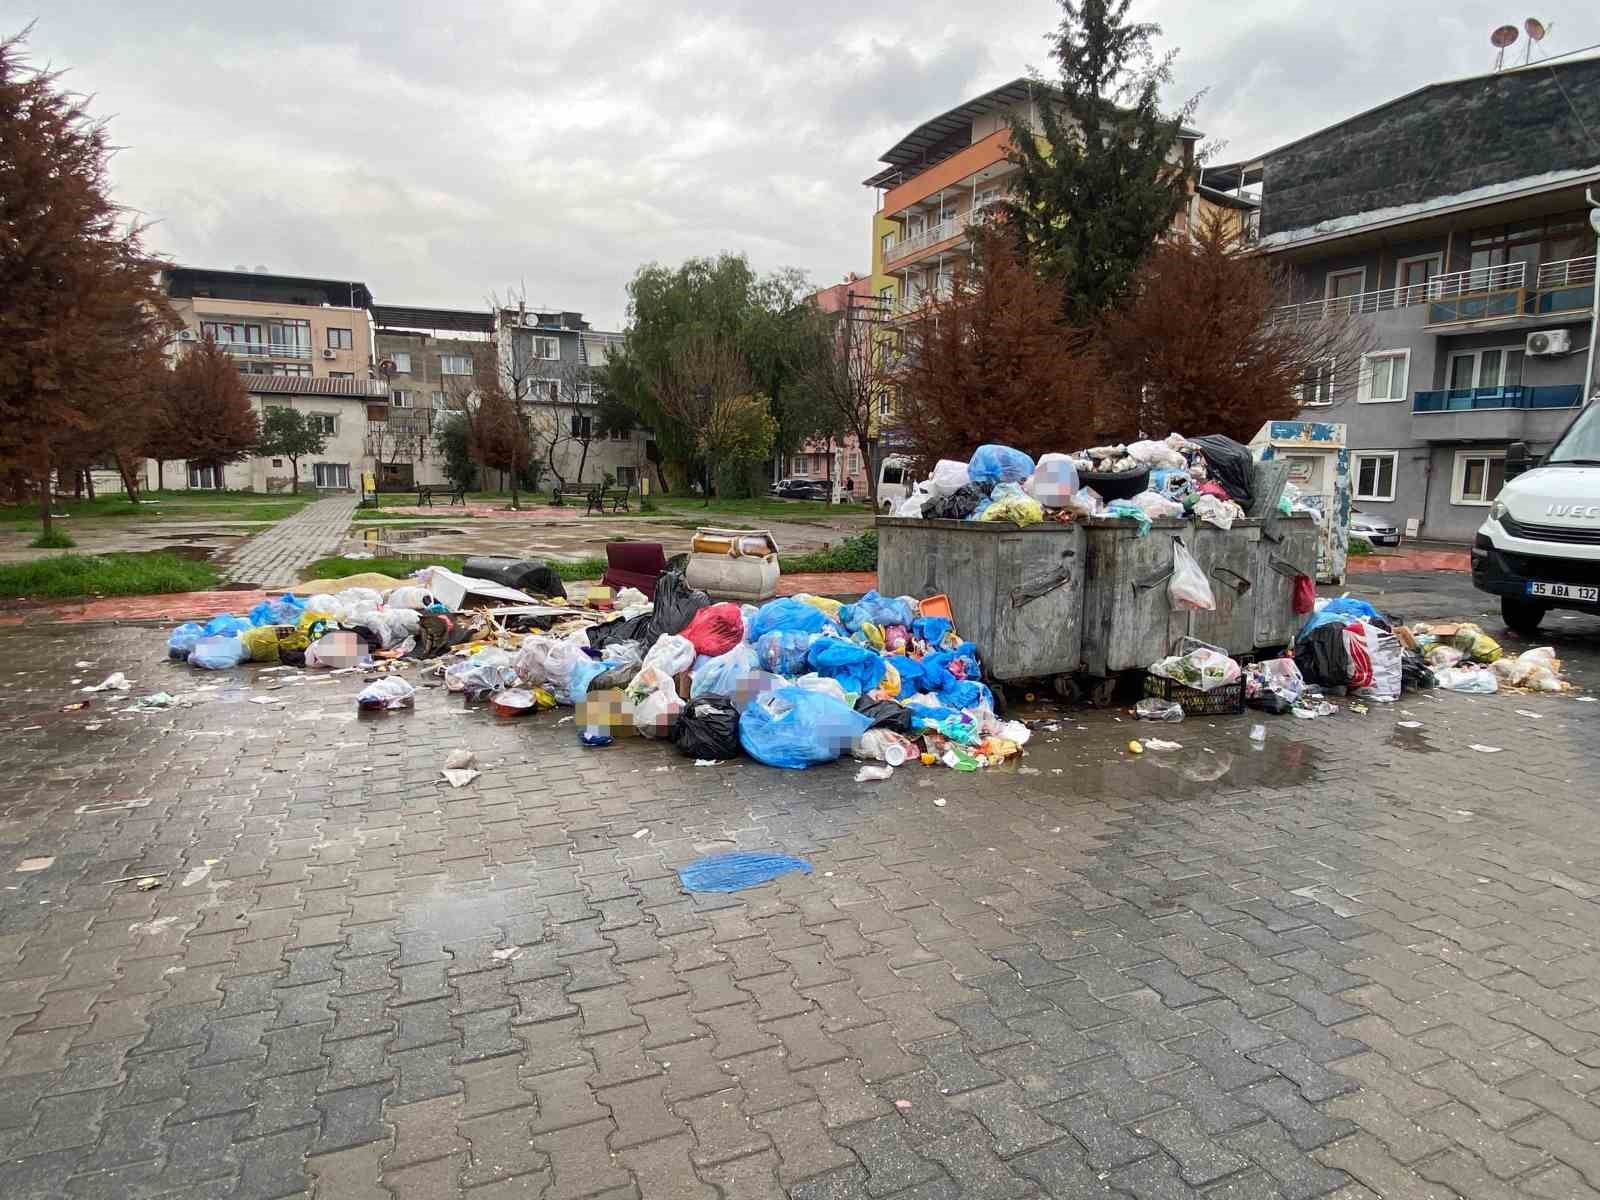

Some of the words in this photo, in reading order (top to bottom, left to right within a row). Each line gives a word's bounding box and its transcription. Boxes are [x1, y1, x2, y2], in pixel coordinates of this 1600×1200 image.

[1533, 583, 1546, 594] 35
[1551, 585, 1569, 597] ABA
[1577, 588, 1597, 600] 132
